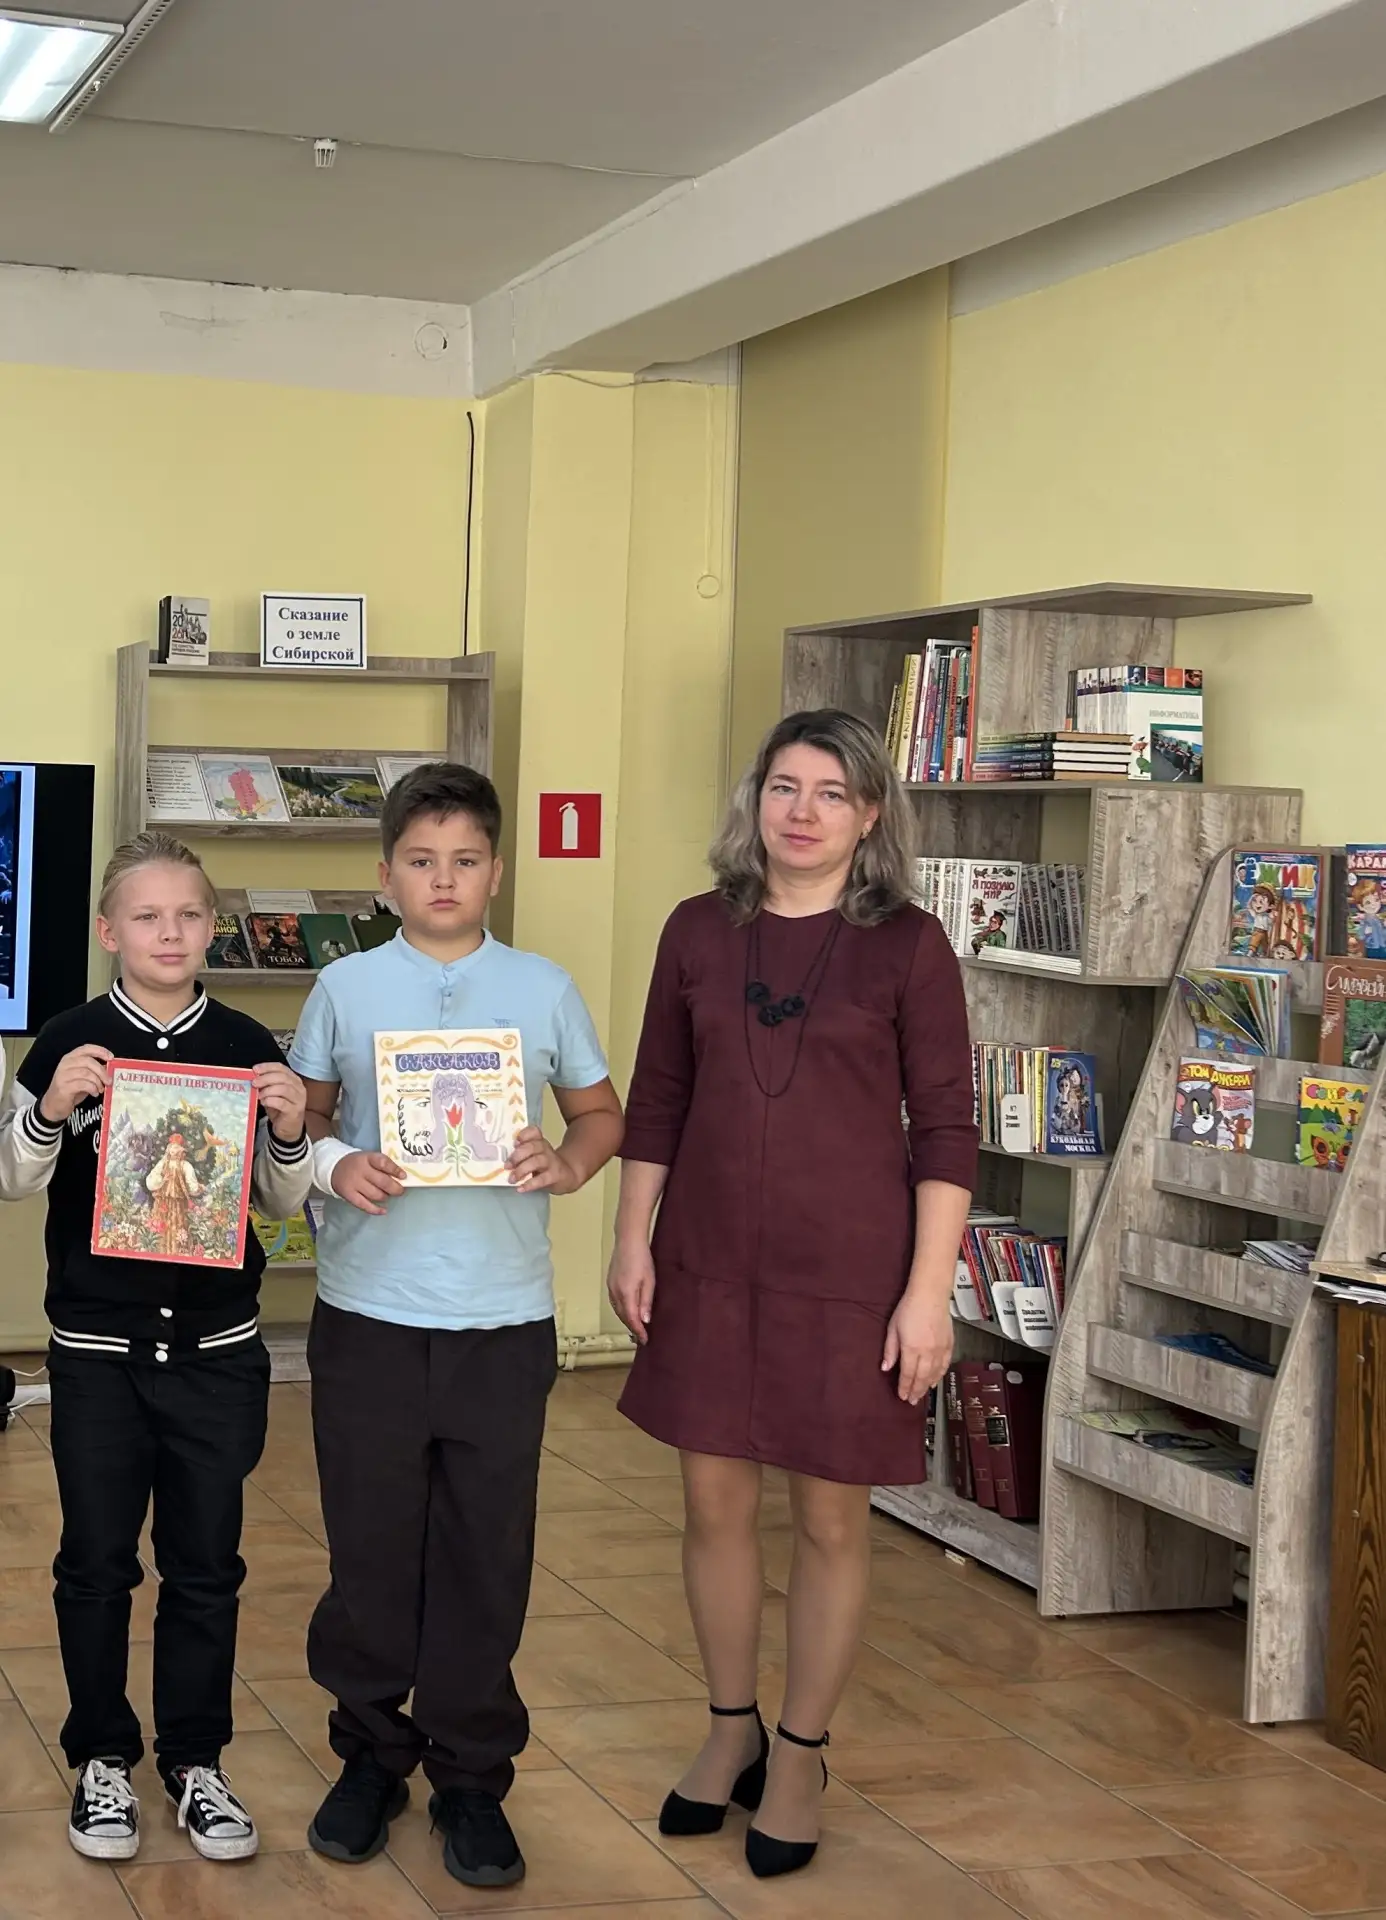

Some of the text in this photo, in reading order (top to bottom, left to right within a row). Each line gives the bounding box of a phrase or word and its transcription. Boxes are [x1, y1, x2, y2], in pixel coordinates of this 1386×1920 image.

[278, 607, 349, 621] Сказание
[286, 630, 341, 641] о земле
[272, 645, 355, 663] Сибирской
[972, 880, 1015, 890] Я ПОЗНАЮ
[983, 891, 1002, 899] МИР
[1188, 1065, 1209, 1079] ТОМ
[1210, 1071, 1250, 1087] ДЖЕРРИ
[117, 1072, 247, 1092] АЛЕНЬКИЙ ЦВЕТОЧЕК
[1064, 1144, 1097, 1152] МОСКВА
